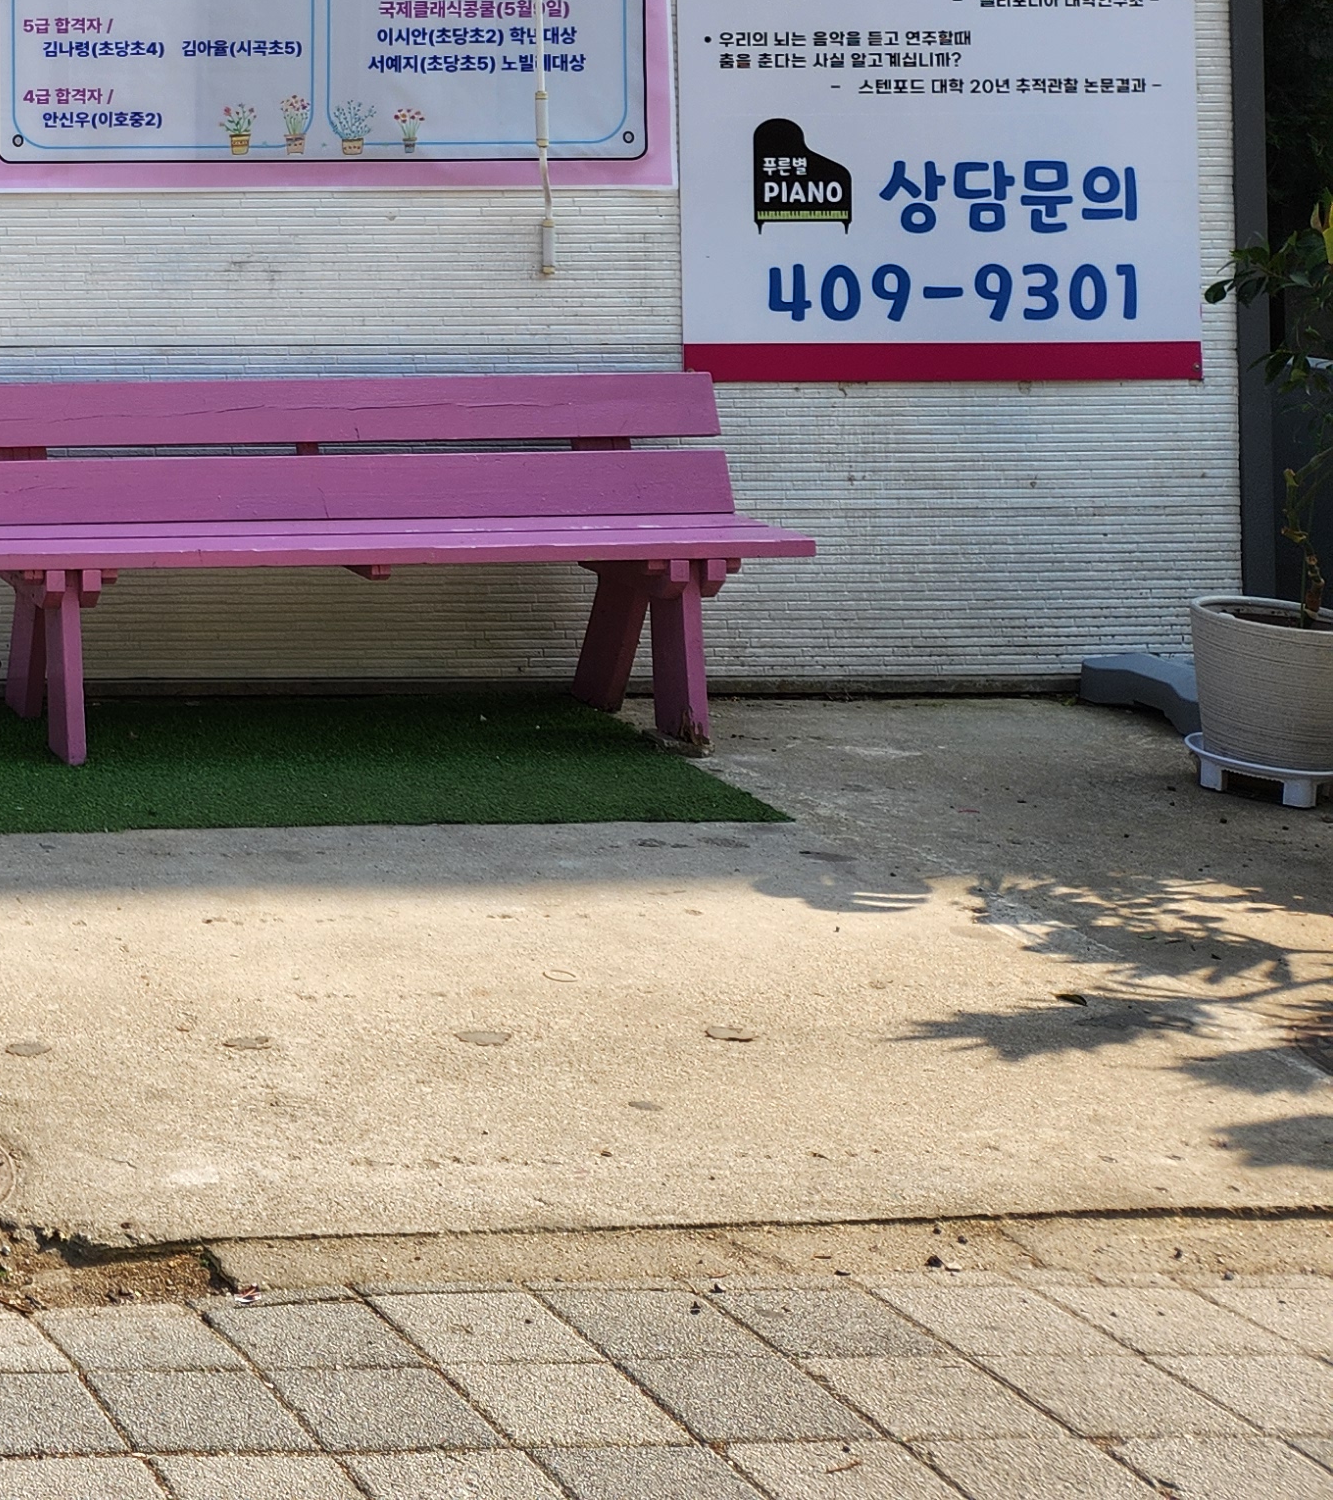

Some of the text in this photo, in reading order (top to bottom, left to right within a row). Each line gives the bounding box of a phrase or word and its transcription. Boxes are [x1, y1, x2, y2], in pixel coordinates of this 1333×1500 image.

[379, 1, 569, 19] 국제클래식콩쿨(5월일)
[24, 18, 102, 34] 5급 합격자
[377, 28, 504, 46] 이시안(초당초2)
[719, 30, 971, 47] 우리의 뇌는 음악을 듣고 연주할때
[43, 40, 302, 58] 김나령(초당초4) 김아율(시곡초5)
[368, 55, 496, 73] 서예지(초당초5)
[719, 52, 961, 68] 춤을 춘다는 사실 알고계십니까?
[859, 78, 1146, 94] 스텐포드 대학 20년 추적관찰 논문결과
[23, 88, 102, 104] 4급 합격자
[43, 112, 162, 129] 안신우(이호중2)
[763, 157, 807, 176] 푸른별
[764, 181, 842, 203] PIANO
[879, 161, 1137, 233] 상담문의
[769, 264, 1137, 322] 409-9301
